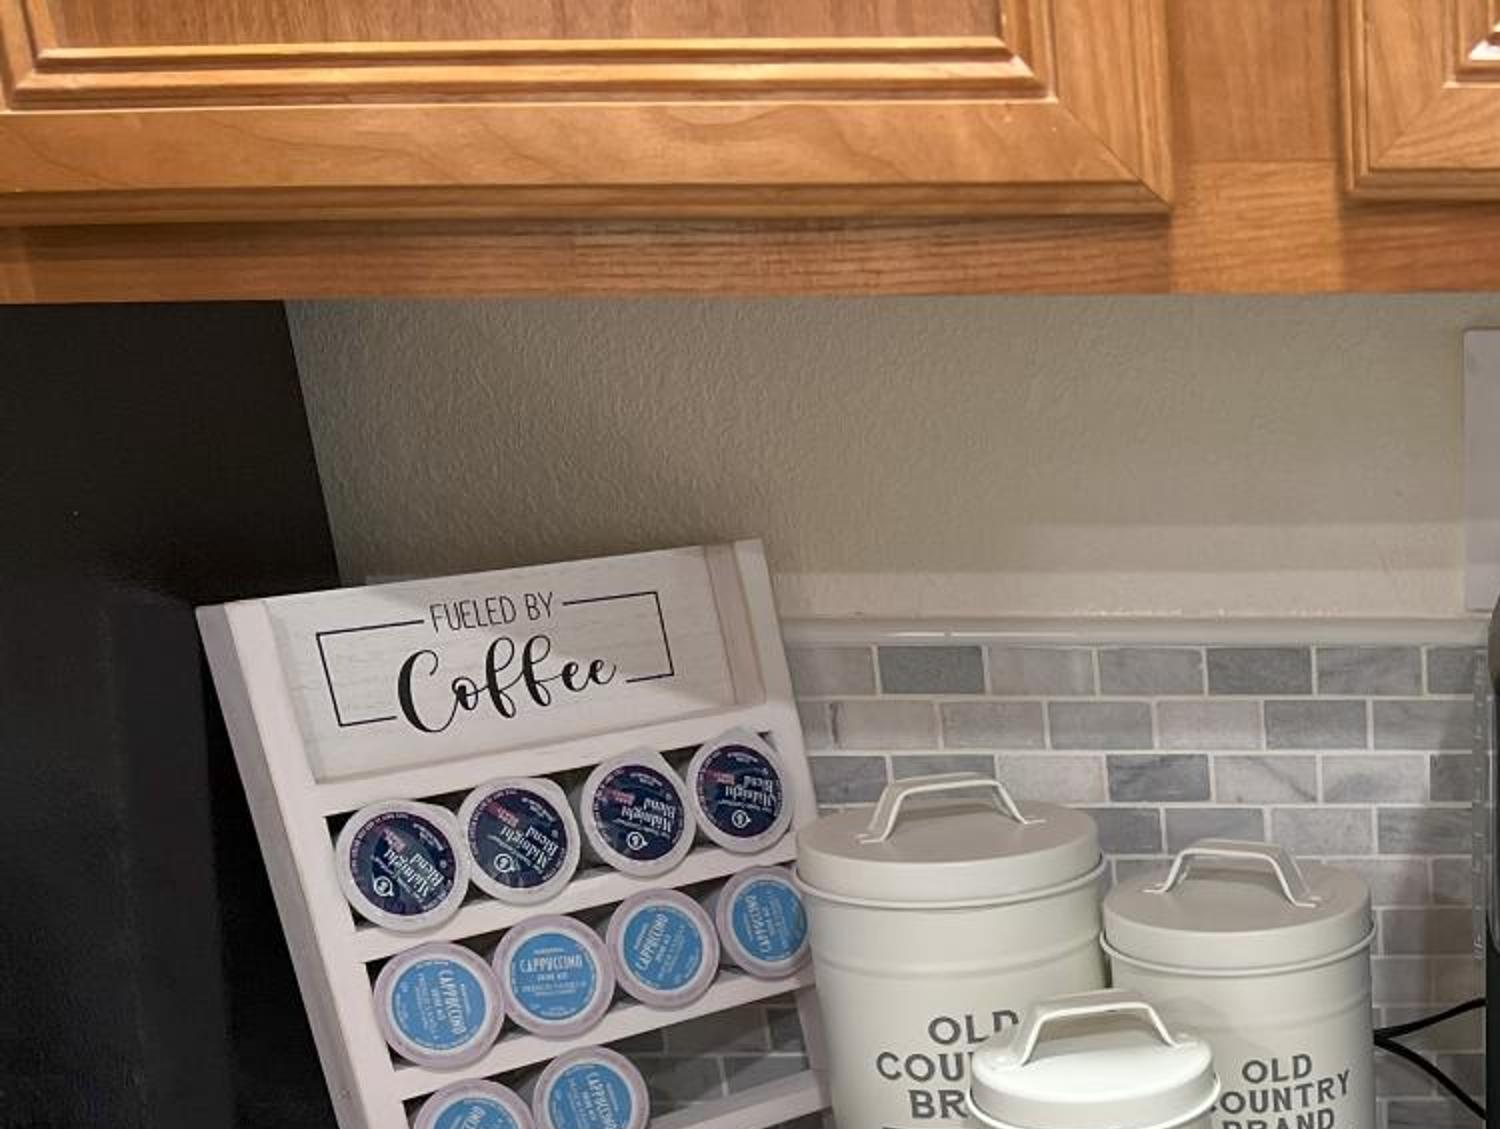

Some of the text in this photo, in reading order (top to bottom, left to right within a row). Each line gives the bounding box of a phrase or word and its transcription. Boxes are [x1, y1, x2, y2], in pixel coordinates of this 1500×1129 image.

[430, 591, 554, 633] FUELED BY
[397, 635, 617, 734] Coffee
[519, 954, 584, 973] CAPPUCCINO
[1242, 1053, 1313, 1084] OLD
[1212, 1069, 1350, 1115] OUNTRY
